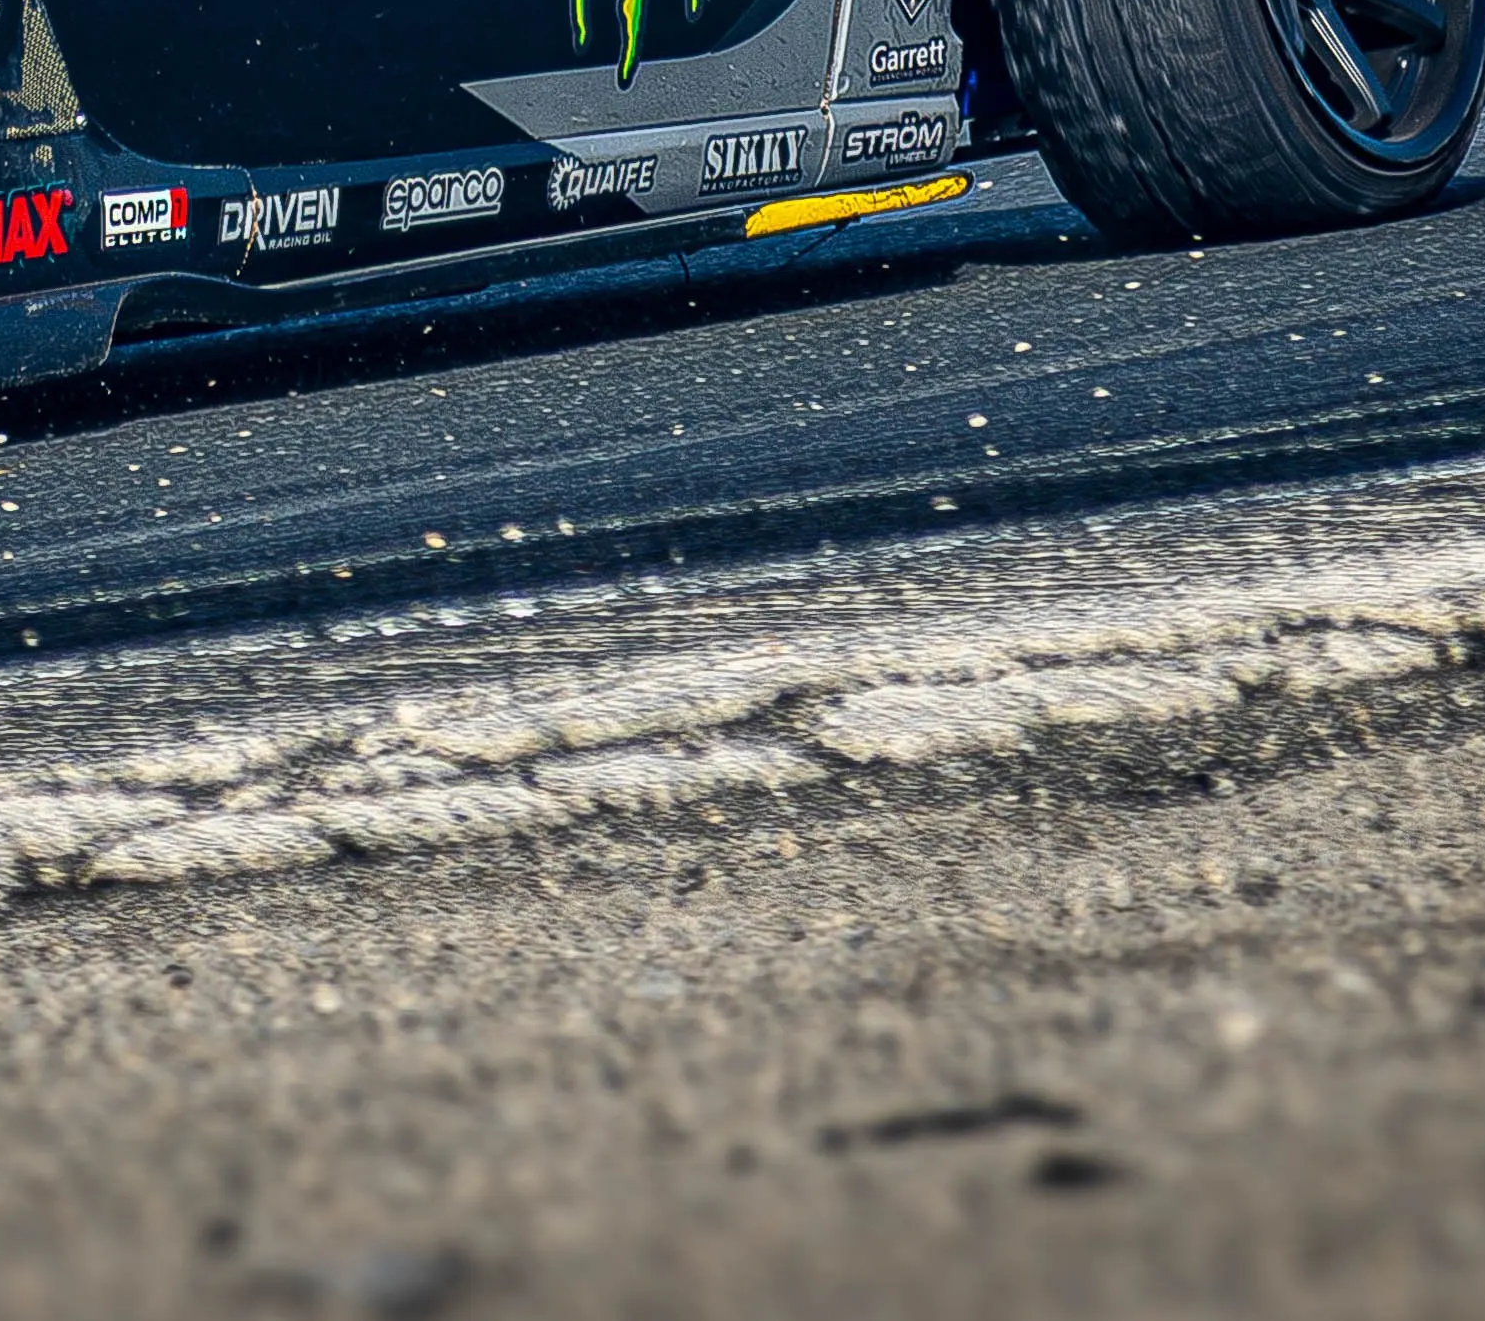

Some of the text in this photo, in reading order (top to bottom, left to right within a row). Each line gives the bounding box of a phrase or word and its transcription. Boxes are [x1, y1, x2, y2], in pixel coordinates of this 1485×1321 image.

[871, 39, 946, 72] Garrett
[703, 129, 807, 181] SIKKY
[386, 168, 503, 224] sparco
[106, 227, 187, 247] CLUTCH
[222, 188, 339, 250] DRIVEN
[268, 230, 332, 250] RACING OIL
